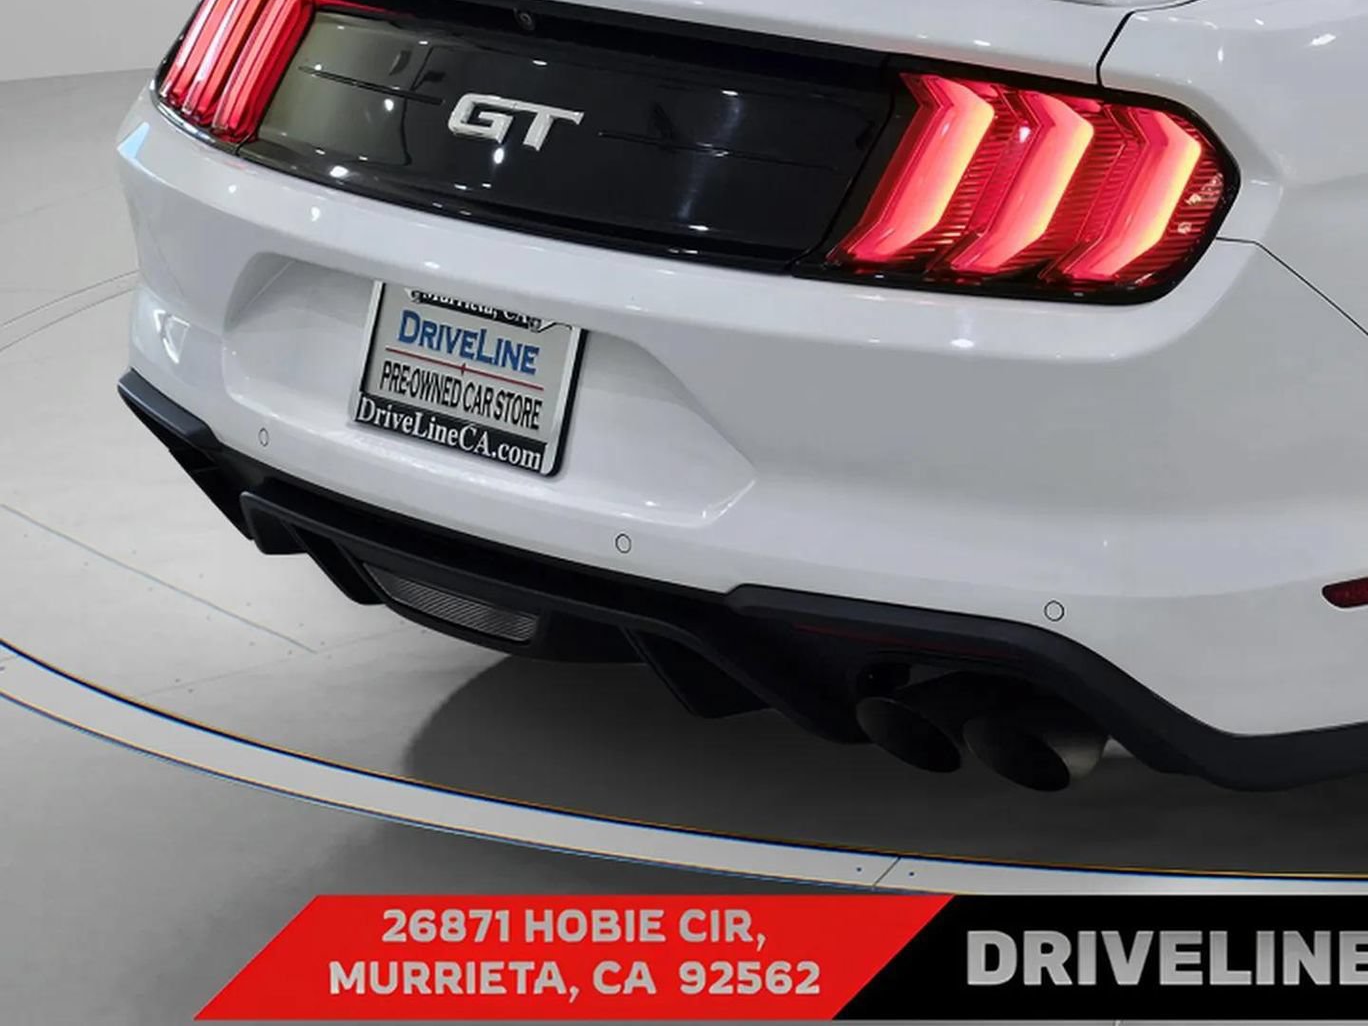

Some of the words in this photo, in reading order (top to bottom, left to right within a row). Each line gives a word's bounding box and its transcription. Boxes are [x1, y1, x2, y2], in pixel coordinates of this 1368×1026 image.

[448, 93, 584, 151] GT
[358, 396, 542, 471] DriveLineCA.com
[463, 382, 494, 417] CAR
[494, 389, 543, 430] STORE
